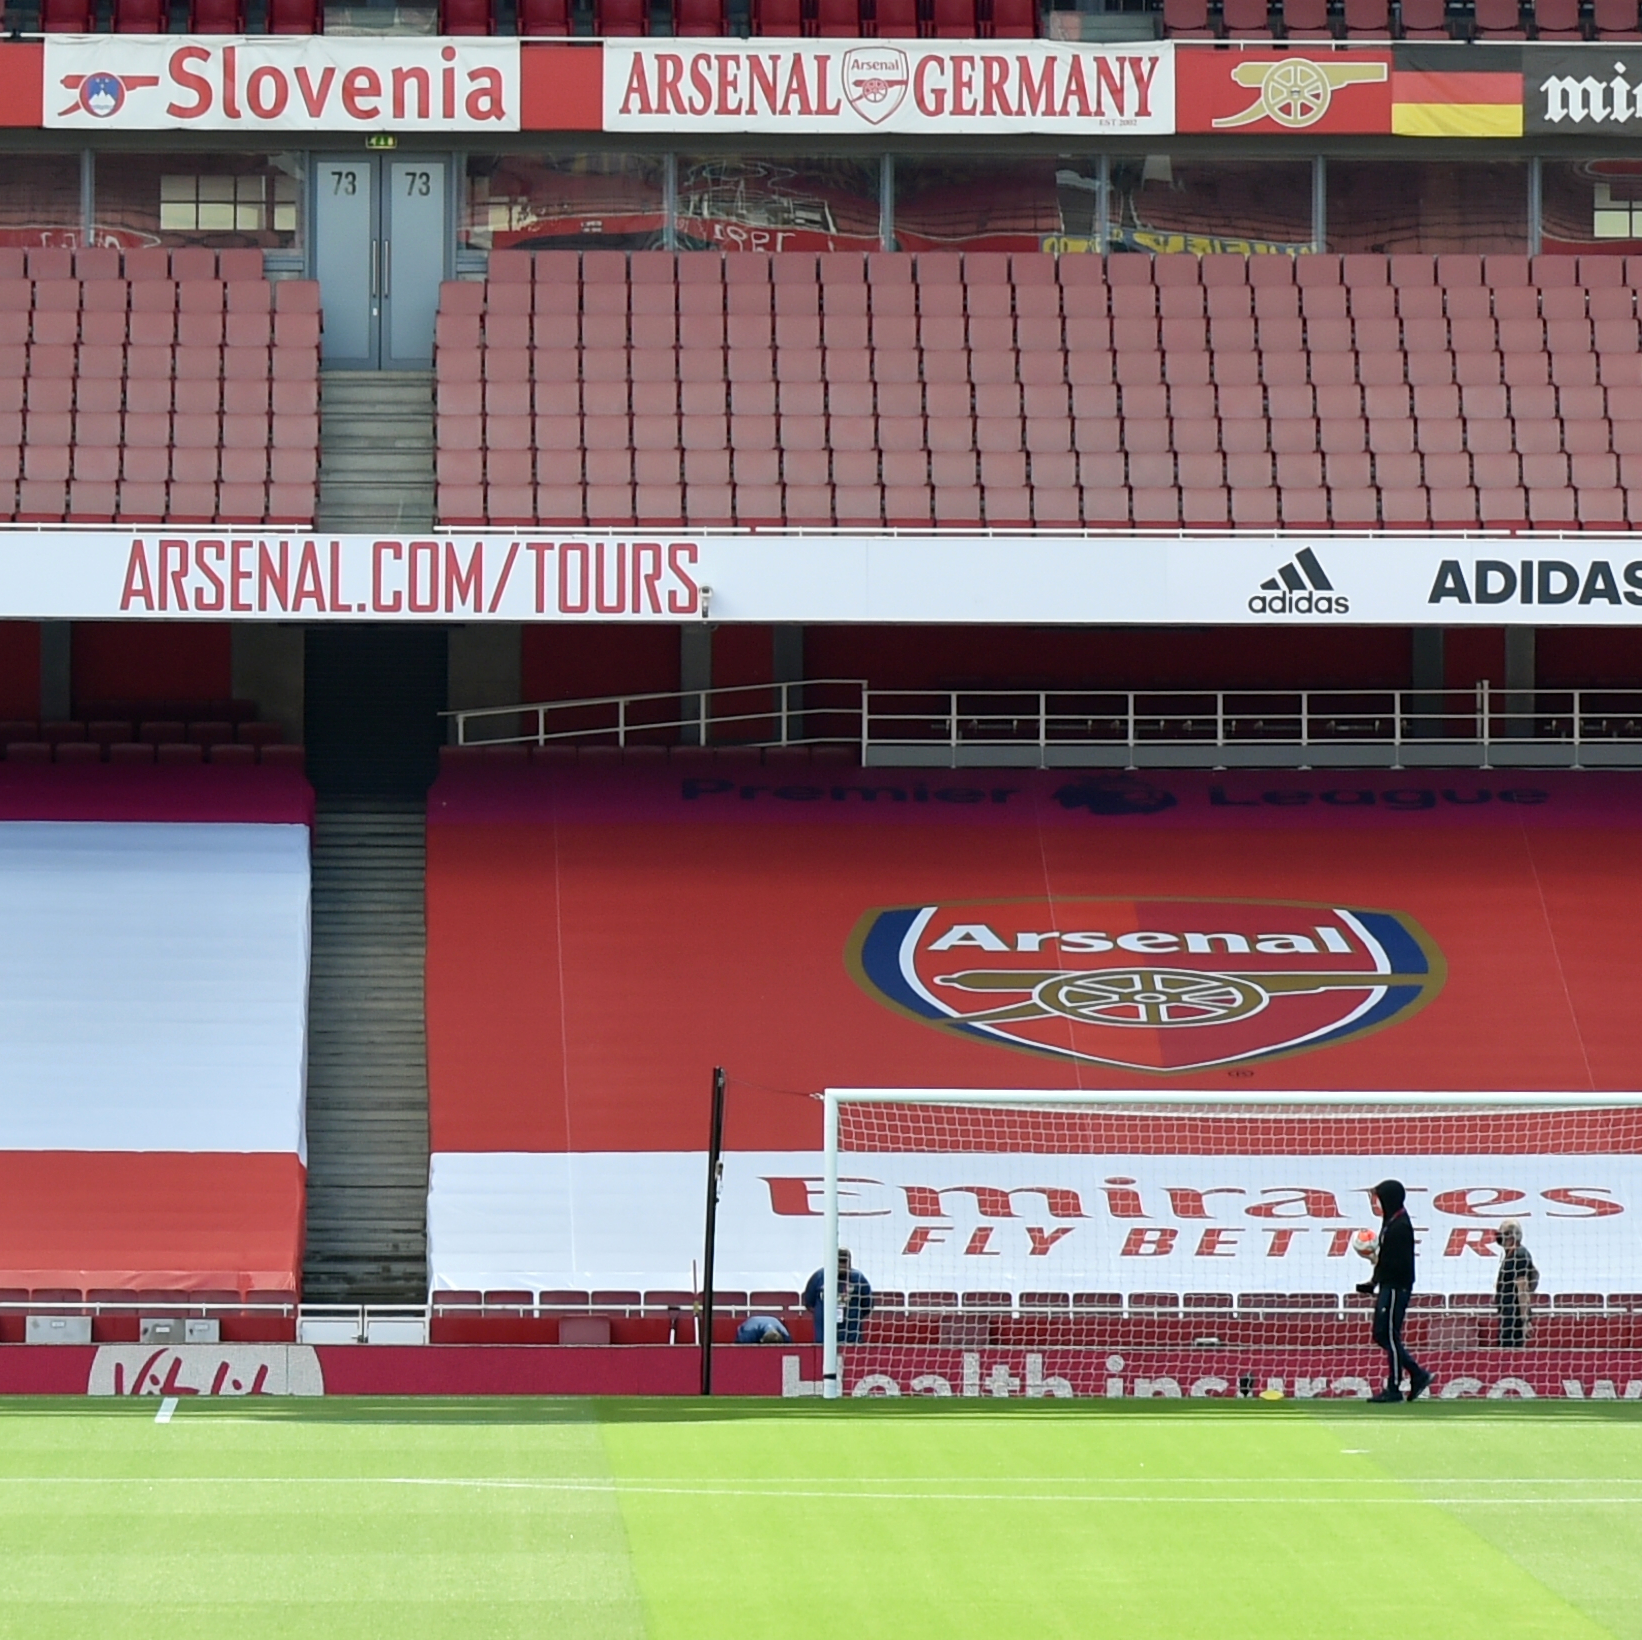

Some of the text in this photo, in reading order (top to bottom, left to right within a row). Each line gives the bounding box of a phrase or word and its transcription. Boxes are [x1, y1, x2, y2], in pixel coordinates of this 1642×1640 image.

[850, 59, 899, 71] Arsenal
[166, 46, 506, 122] Slovenia
[618, 52, 1160, 117] ARSENAL GERMANY
[331, 171, 357, 196] 73
[405, 172, 431, 196] 73
[119, 539, 700, 615] ARSENAL.COM/TOURS
[1247, 591, 1350, 615] adidas
[681, 778, 1552, 810] Premier League
[926, 920, 1353, 956] Arsenal
[758, 1176, 1626, 1219] Emiraes
[902, 1227, 1501, 1258] FLY BETTR
